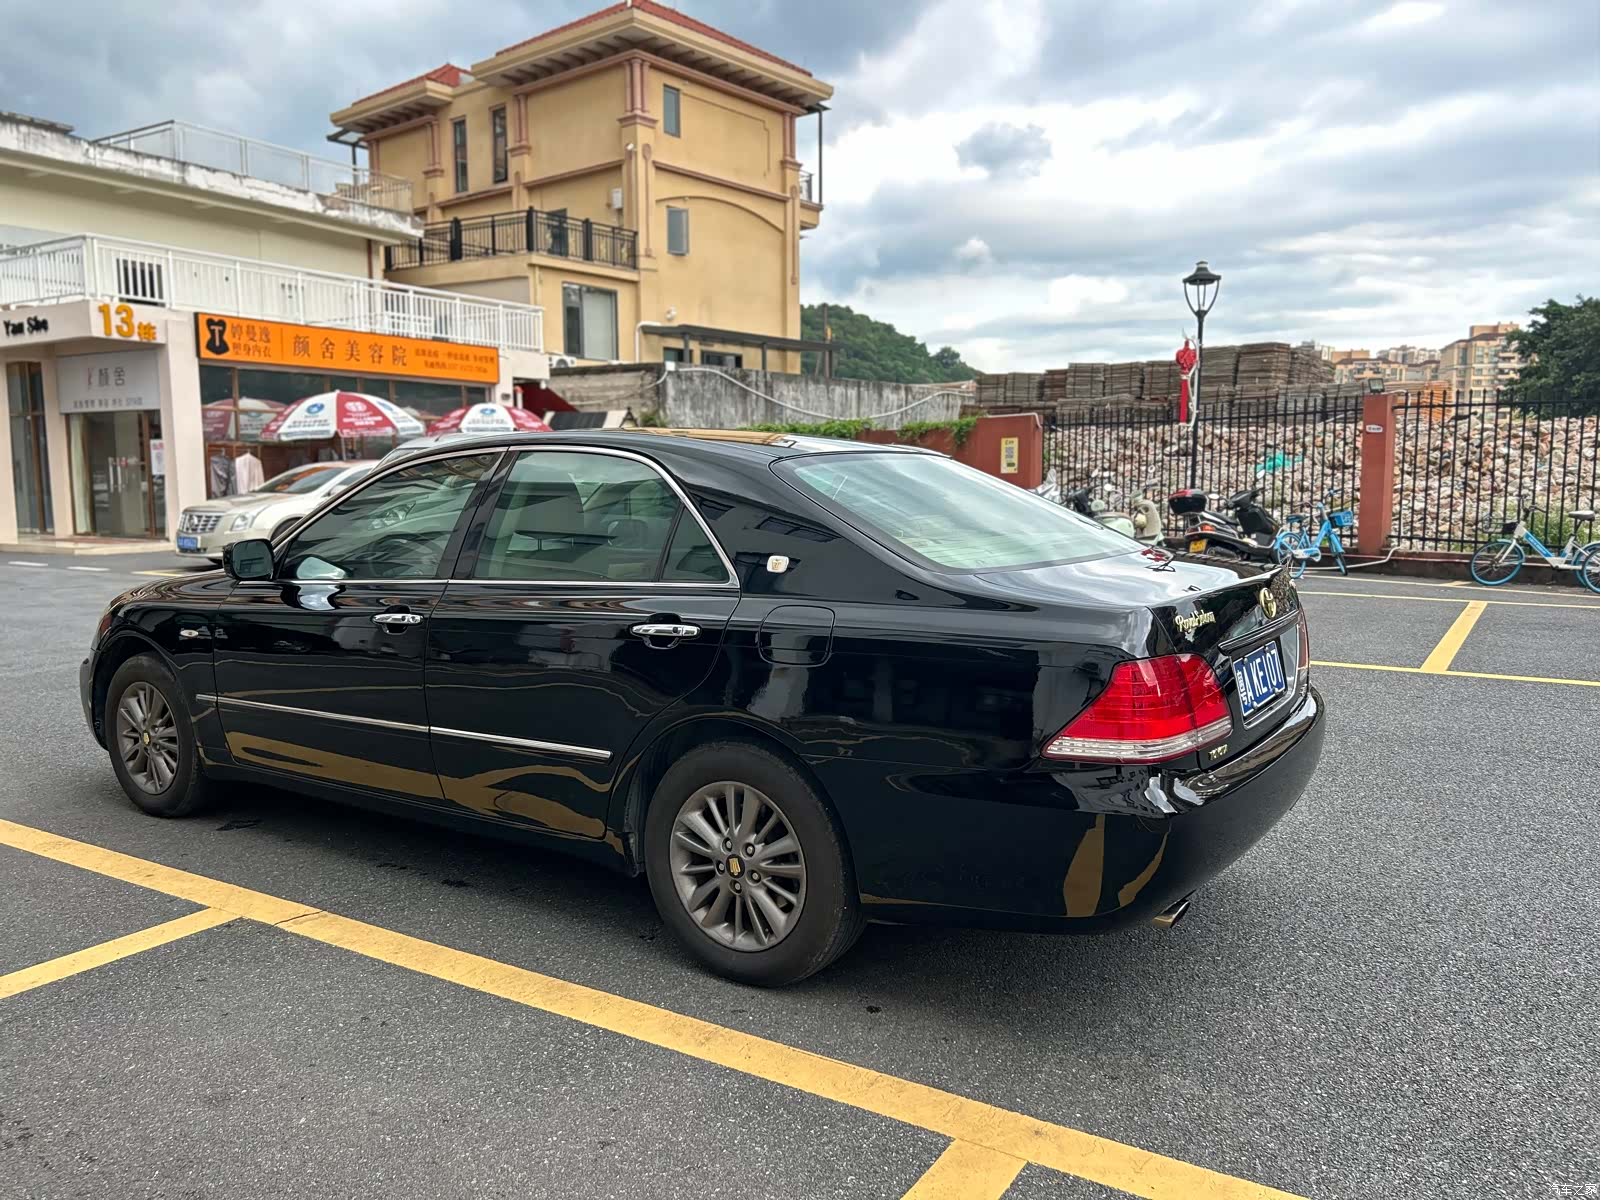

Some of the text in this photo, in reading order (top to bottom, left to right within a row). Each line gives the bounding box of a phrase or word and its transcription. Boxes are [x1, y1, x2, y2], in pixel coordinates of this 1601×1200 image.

[293, 334, 407, 367] 颜舍美容院
